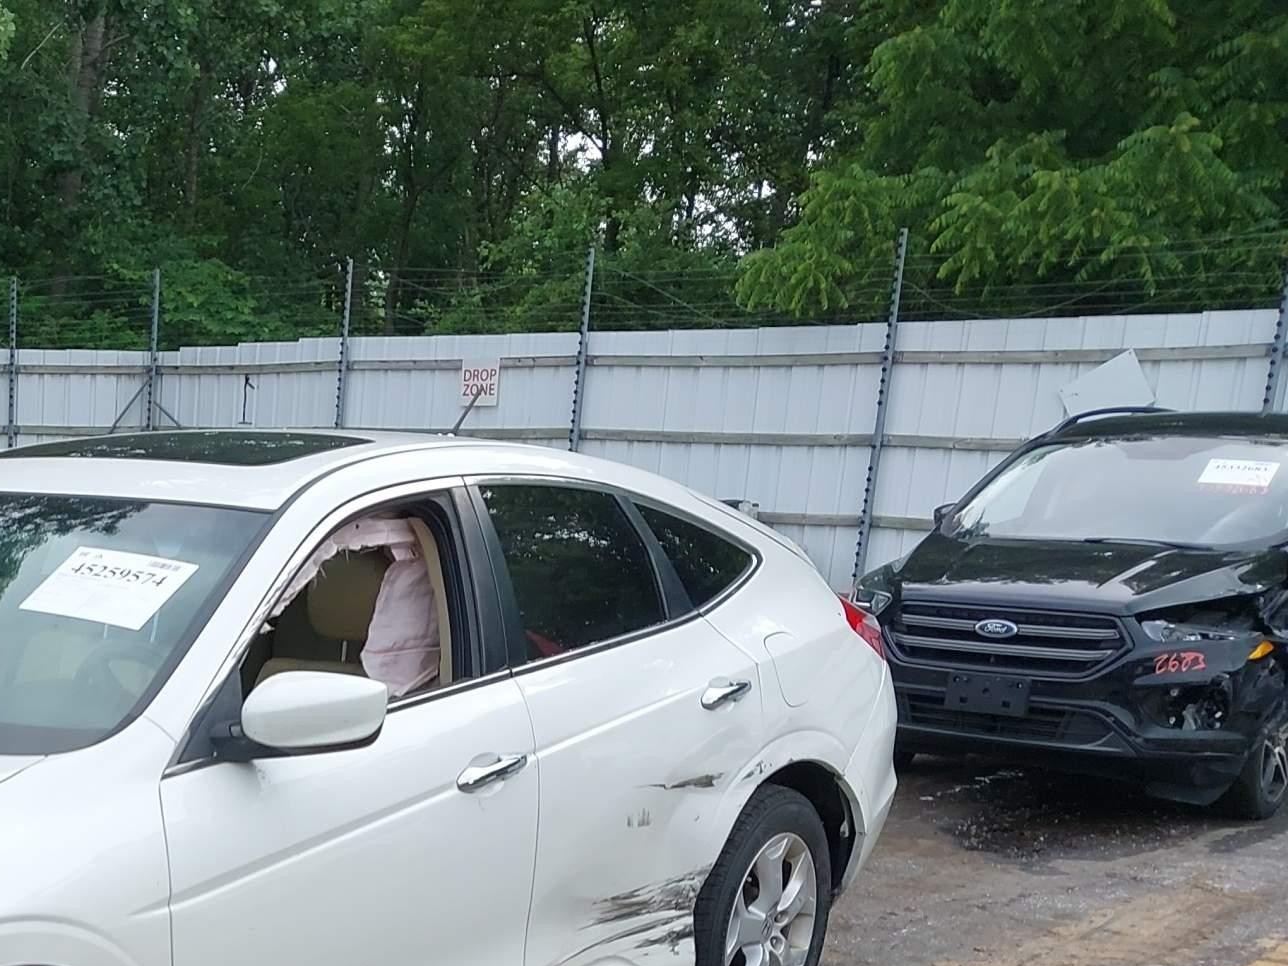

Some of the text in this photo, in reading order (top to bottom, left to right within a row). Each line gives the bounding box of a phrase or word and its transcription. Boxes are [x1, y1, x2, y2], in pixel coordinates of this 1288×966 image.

[463, 368, 497, 382] DROP
[462, 383, 495, 397] ZONE
[72, 562, 169, 587] 45259574
